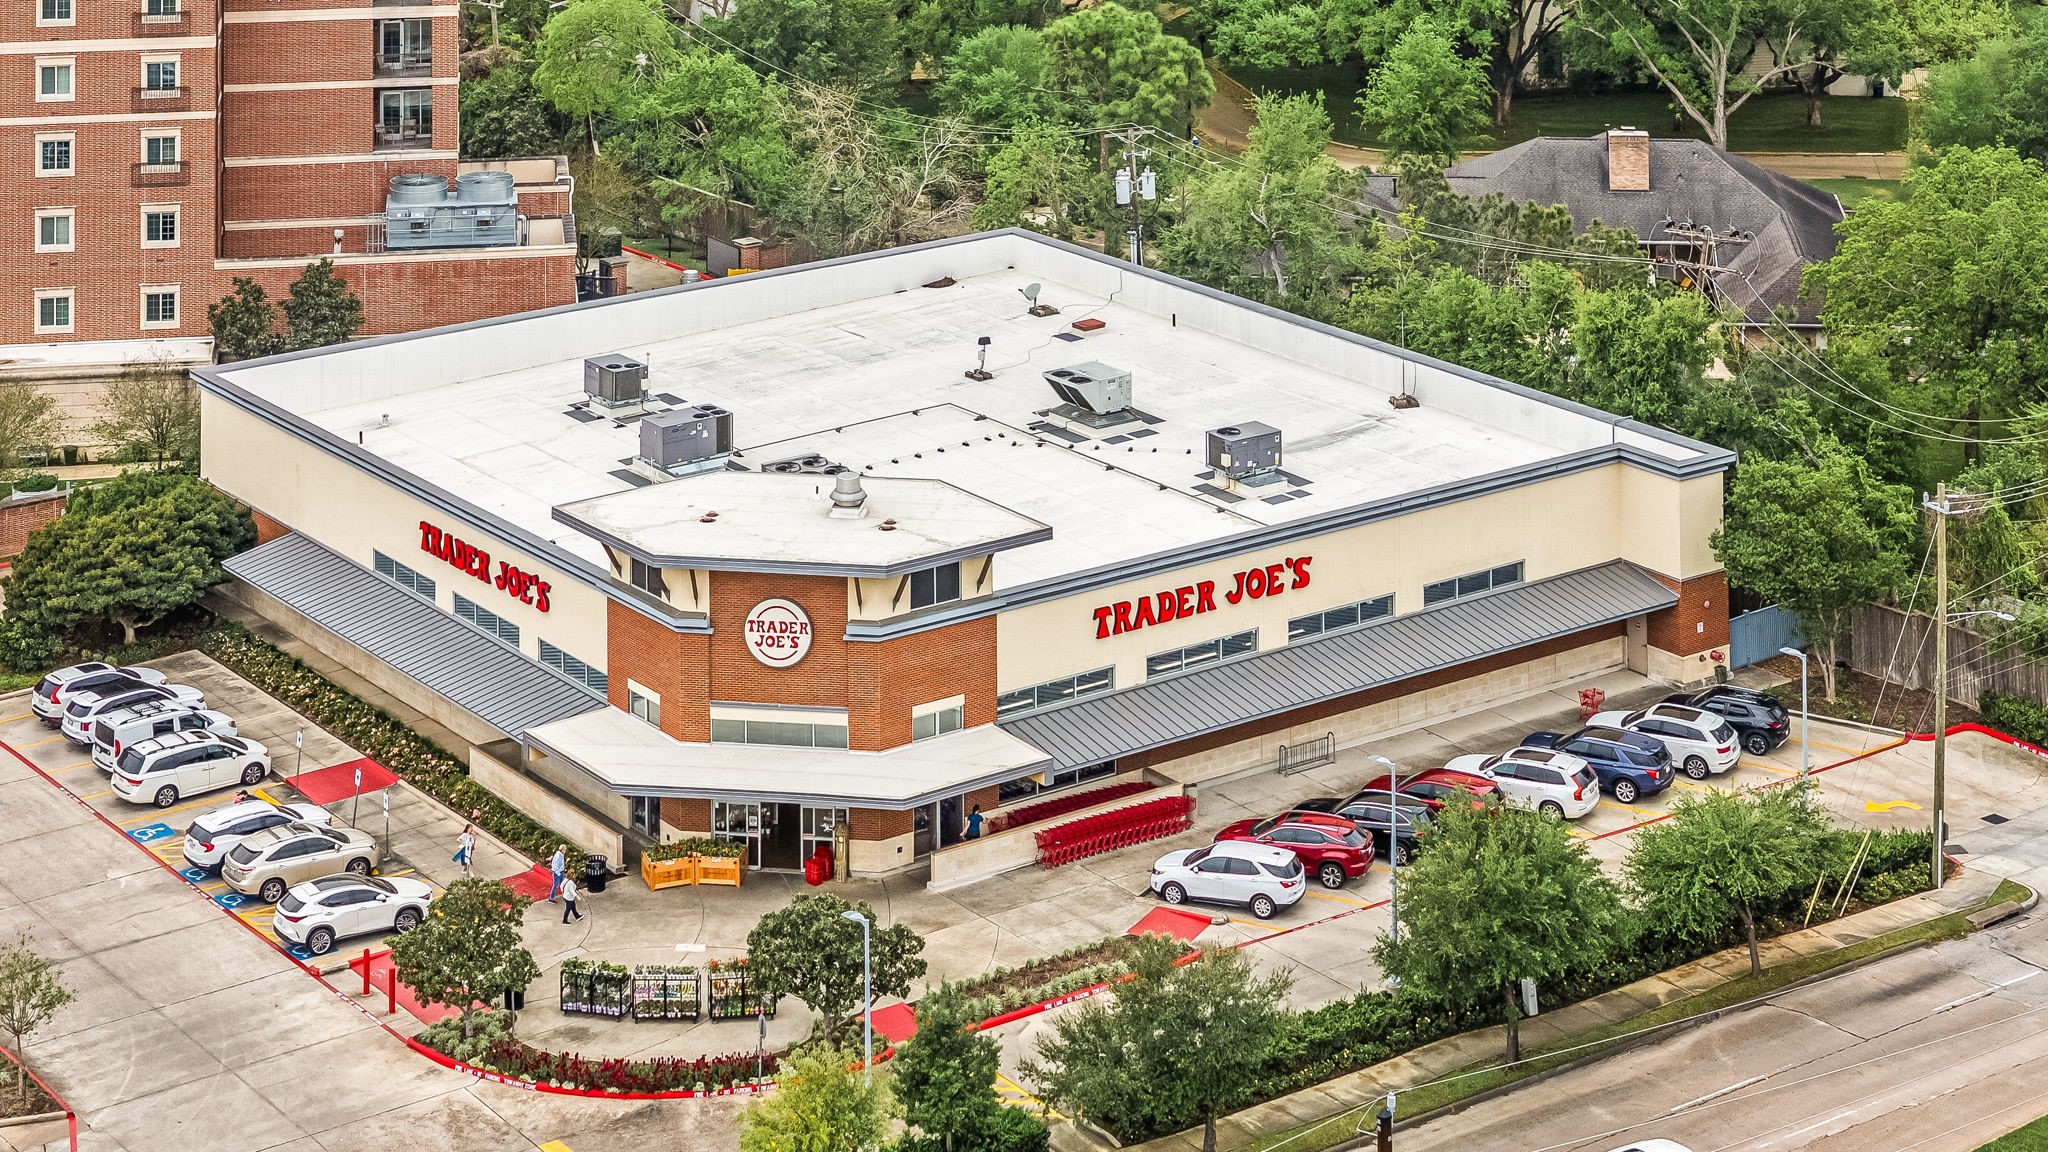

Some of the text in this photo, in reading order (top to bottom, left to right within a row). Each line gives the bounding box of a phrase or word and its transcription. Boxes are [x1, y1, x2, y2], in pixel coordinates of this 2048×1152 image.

[419, 520, 552, 613] TRADER JOE'S
[1092, 556, 1313, 640] TRADER JOE'S
[747, 620, 809, 634] TRADER
[754, 635, 800, 648] JOE'S
